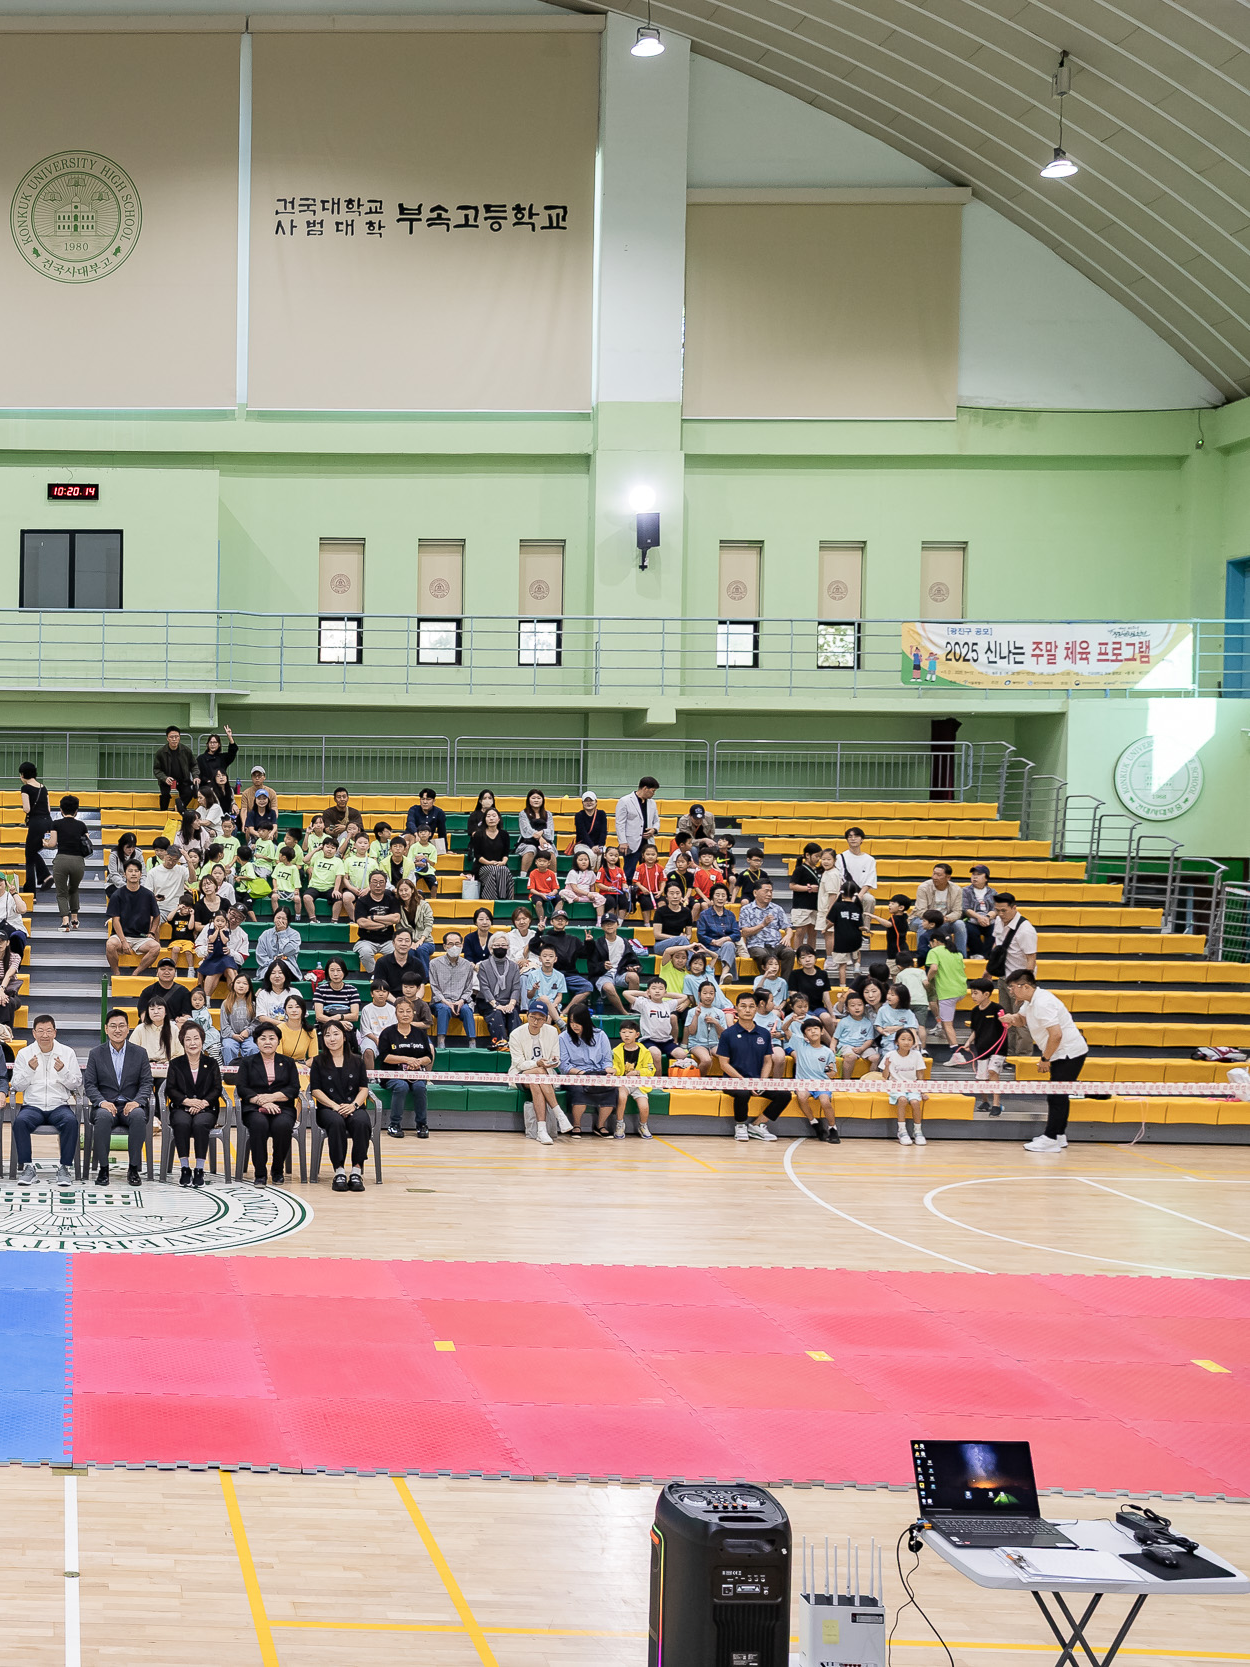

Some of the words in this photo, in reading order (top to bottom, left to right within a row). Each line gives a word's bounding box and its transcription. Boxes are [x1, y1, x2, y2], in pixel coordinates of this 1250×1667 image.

[17, 192, 33, 246] KONKUK
[27, 157, 97, 191] UNIVERSITY
[100, 165, 127, 193] HIGH
[120, 193, 136, 242] SCHOOL
[274, 197, 384, 217] 건국대학교
[395, 202, 568, 235] 부속고등학교
[64, 242, 89, 252] 1980
[41, 257, 113, 278] 건국사대부고
[945, 641, 979, 663] 2025
[984, 640, 1025, 665] 신나는
[1031, 640, 1058, 665] 주말
[1064, 640, 1091, 665] 체육
[1096, 639, 1151, 665] 프로그램
[650, 1010, 670, 1018] FILA
